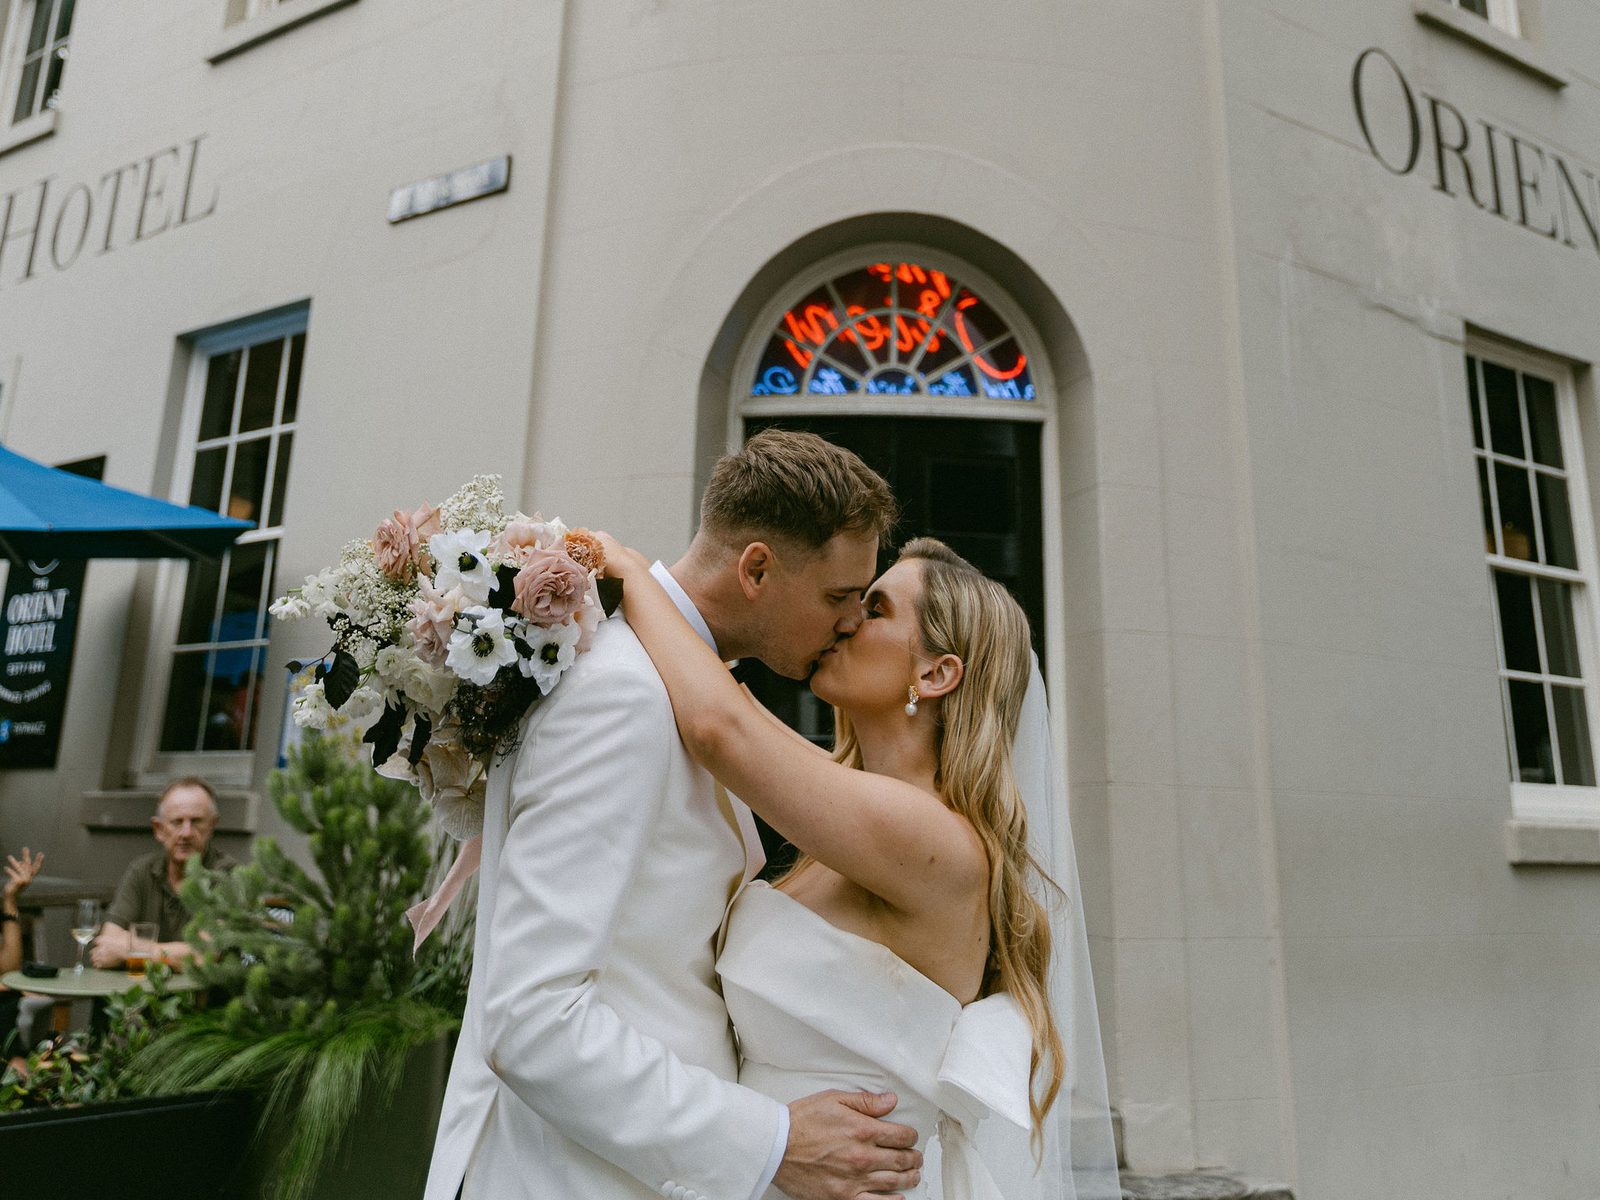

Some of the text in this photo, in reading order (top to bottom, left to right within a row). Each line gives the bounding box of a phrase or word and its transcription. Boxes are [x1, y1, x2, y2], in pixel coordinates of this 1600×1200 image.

[1351, 46, 1600, 259] ORIEN
[0, 132, 221, 284] HOTEL
[5, 622, 56, 655] HOTEL
[7, 588, 70, 624] ORIENT
